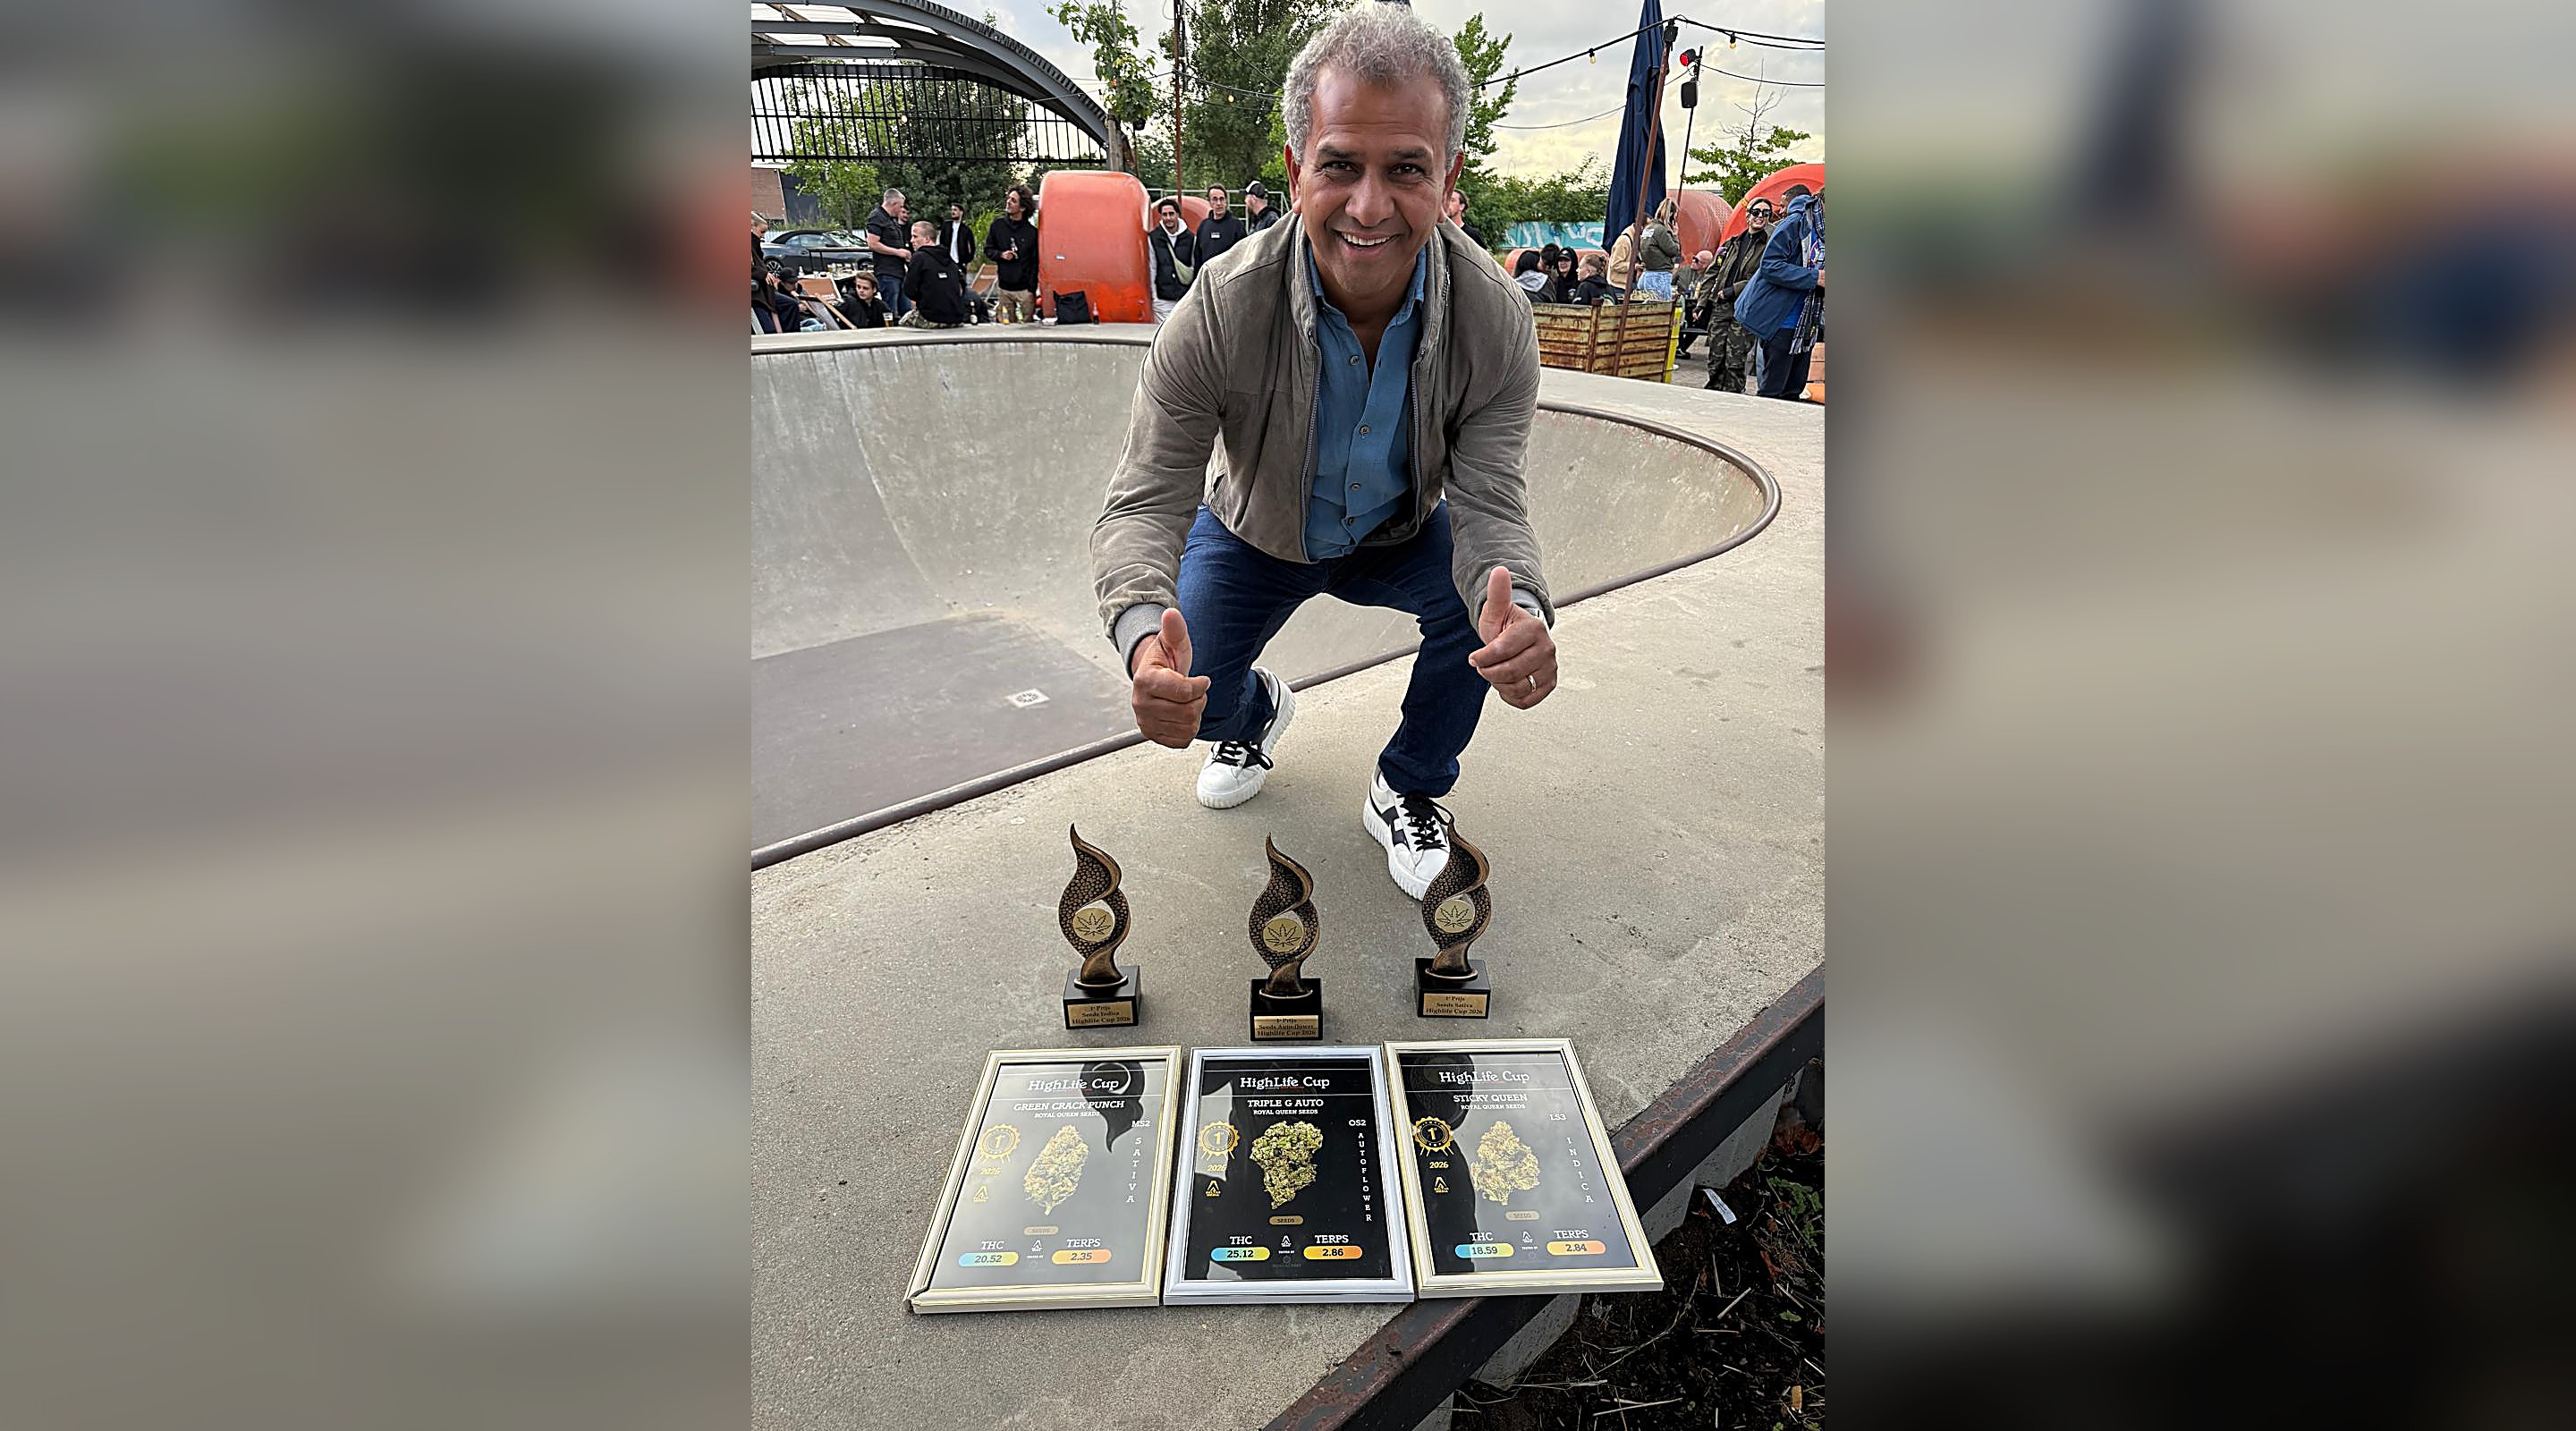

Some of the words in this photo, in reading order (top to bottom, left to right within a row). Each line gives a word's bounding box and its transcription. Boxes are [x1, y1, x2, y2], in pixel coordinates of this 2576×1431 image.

[1439, 1071, 1498, 1085] HighLife
[1502, 1071, 1530, 1084] Cup
[1028, 1079, 1088, 1092] HighLife
[1091, 1078, 1119, 1091] Cup
[1240, 1077, 1299, 1090] HighLife
[1303, 1076, 1330, 1089] Cup
[1247, 1099, 1283, 1107] TRIPLE
[1284, 1099, 1293, 1107] G
[1294, 1099, 1324, 1107] AUTO
[1453, 1095, 1489, 1103] STICKY
[1490, 1094, 1528, 1102] QUEEN
[1013, 1102, 1050, 1111] GREEN
[1051, 1101, 1087, 1110] CRACK
[1088, 1100, 1125, 1109] PUNCH
[1429, 1161, 1449, 1169] 2026
[1126, 1137, 1142, 1203] SATIVA
[1567, 1137, 1594, 1203] INDICA
[1358, 1132, 1372, 1222] AUTOFLOWER
[1315, 1234, 1349, 1244] TERPS
[1469, 1232, 1494, 1241] THC
[1553, 1230, 1589, 1239] TERPS
[980, 1240, 1004, 1250] THC
[1066, 1239, 1101, 1248] TERPS
[1229, 1236, 1253, 1245] THC
[1471, 1246, 1498, 1255] 18.59
[1565, 1243, 1588, 1252] 2.84
[1070, 1252, 1092, 1261] 2.35
[1226, 1249, 1254, 1258] 25.12
[1322, 1248, 1344, 1257] 2.86
[974, 1255, 1002, 1264] 20.52
